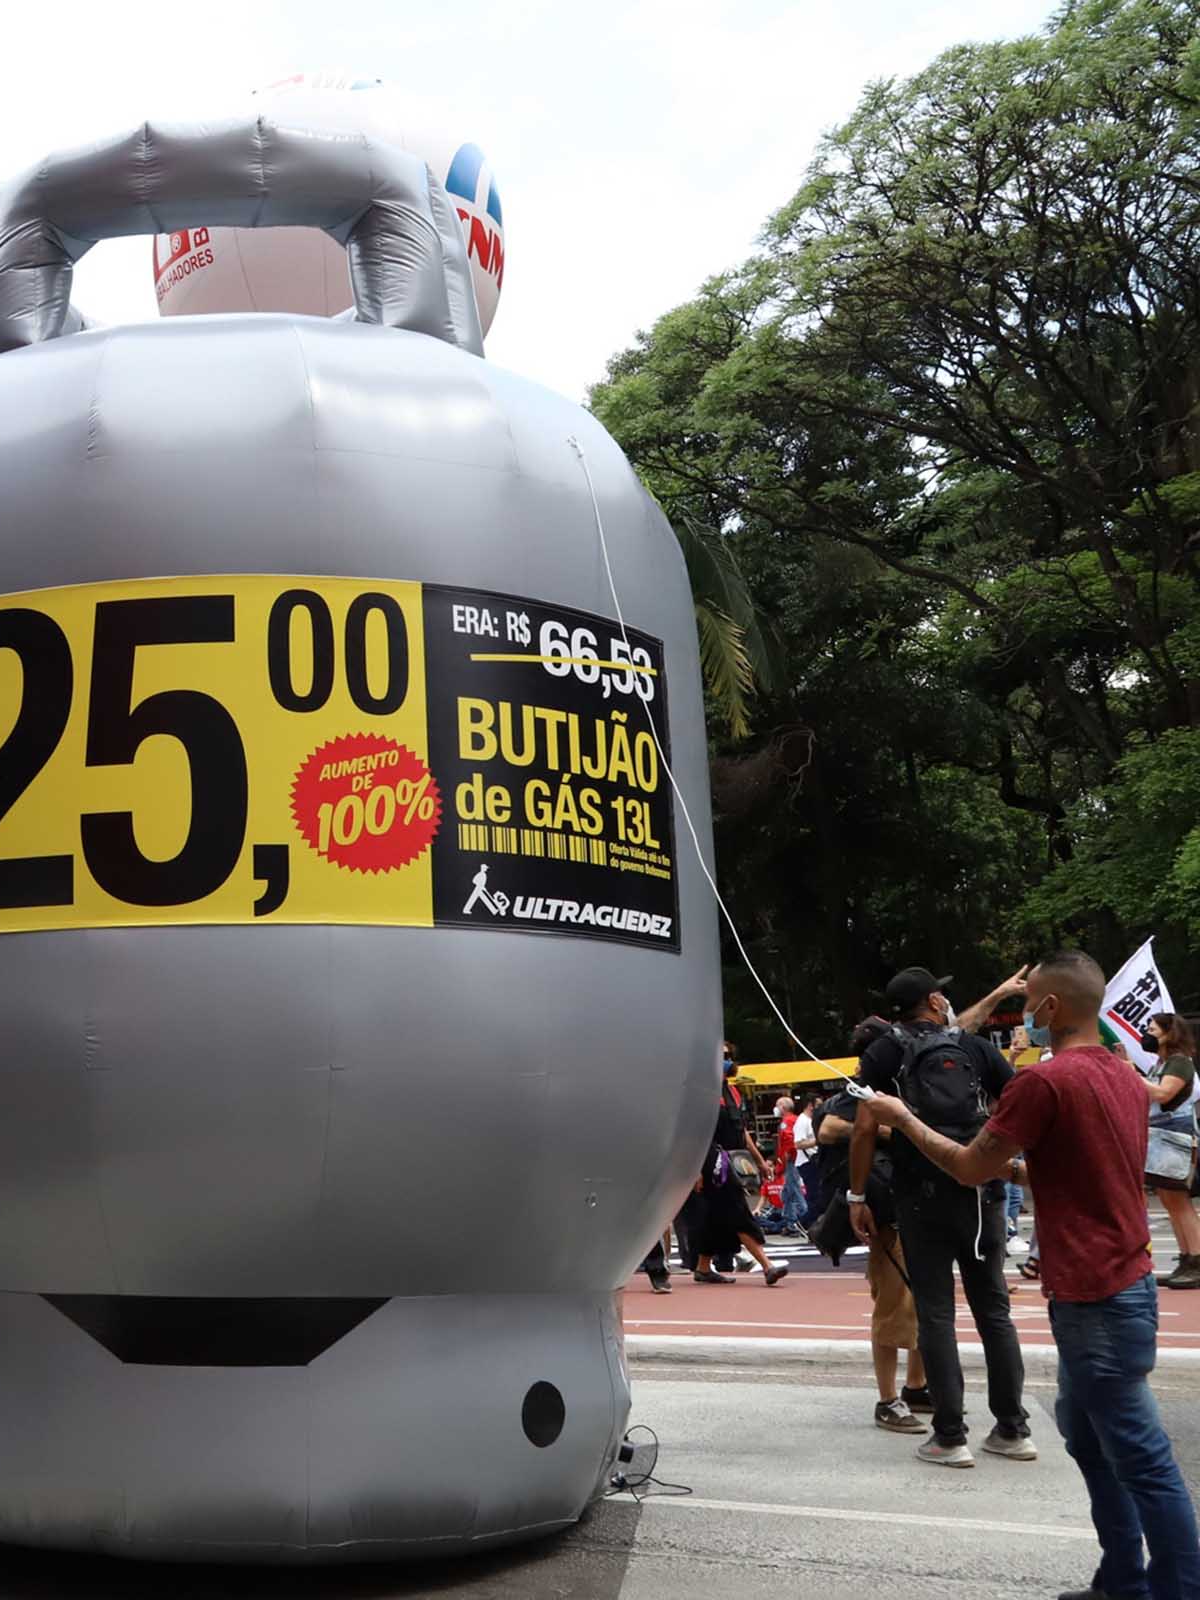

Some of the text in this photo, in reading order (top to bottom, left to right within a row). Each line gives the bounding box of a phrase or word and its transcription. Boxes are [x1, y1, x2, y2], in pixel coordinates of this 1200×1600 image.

[452, 604, 656, 702] ERA: R$ 66,53
[318, 749, 400, 782] AUMENTO
[351, 773, 374, 793] DE
[457, 696, 658, 793] BUTIJÃO
[316, 772, 435, 854] 100%
[455, 773, 661, 850] de GÁS 13L
[512, 895, 673, 938] ULTRAGUEDEZ
